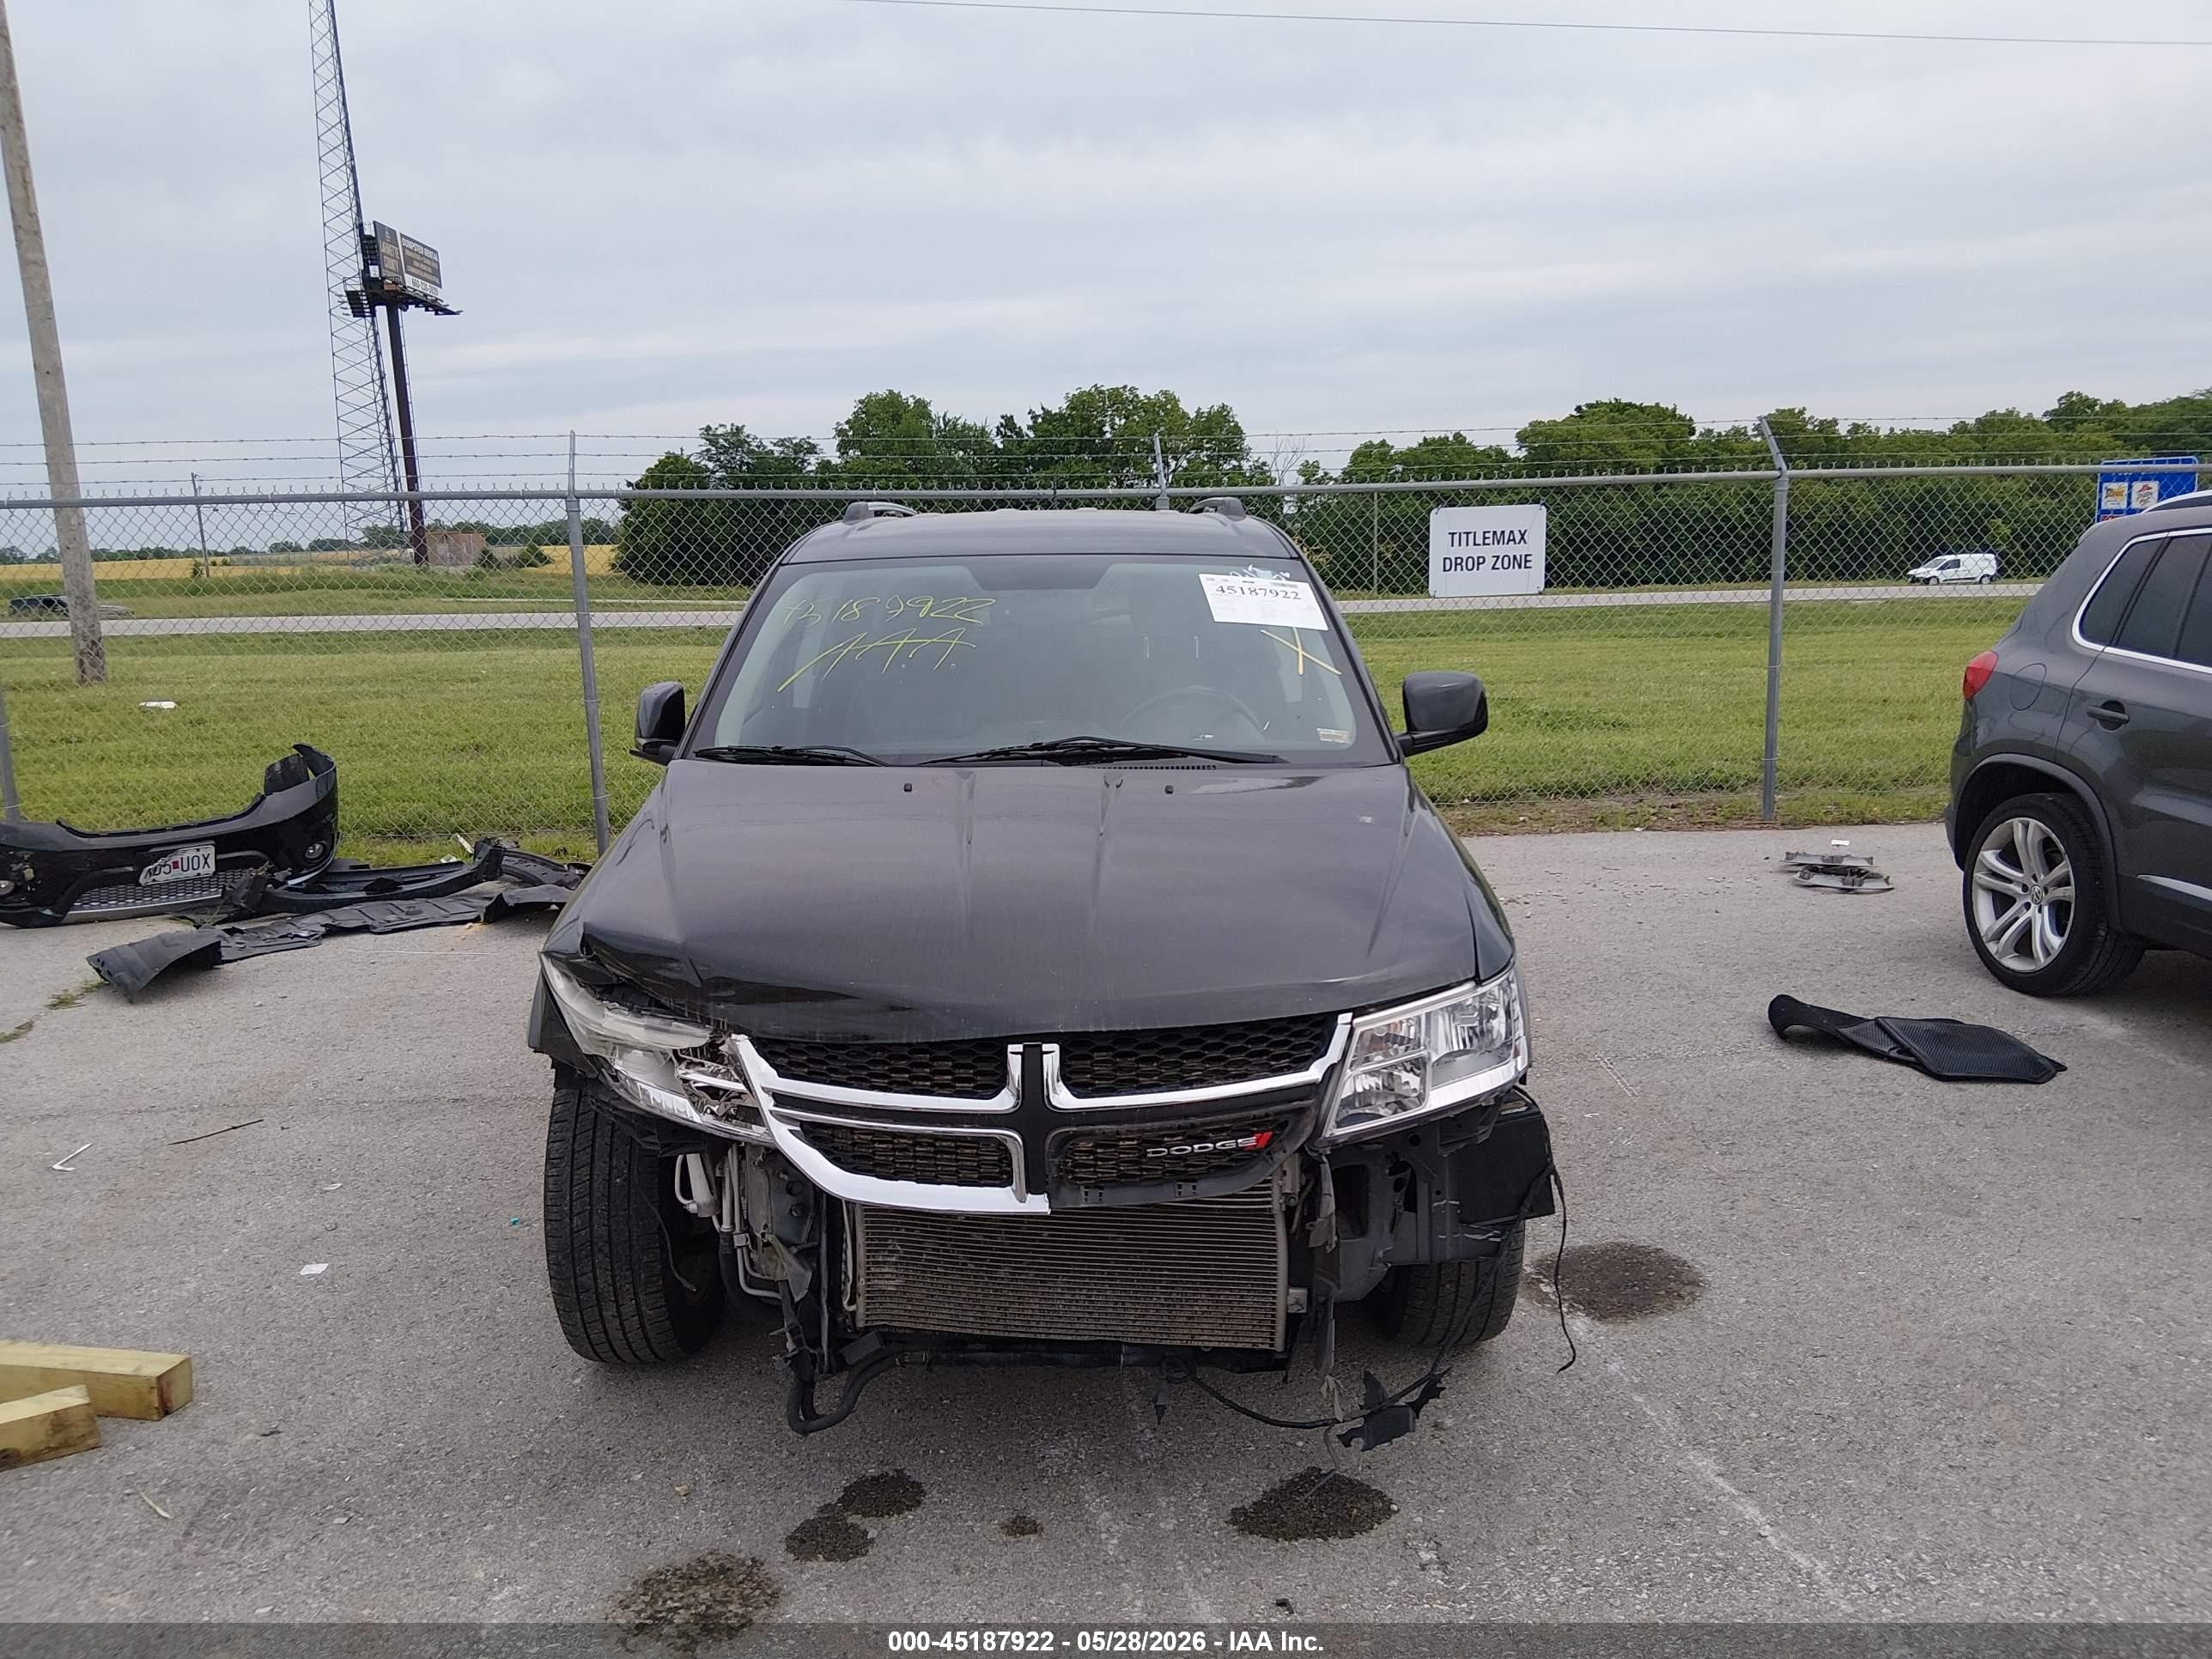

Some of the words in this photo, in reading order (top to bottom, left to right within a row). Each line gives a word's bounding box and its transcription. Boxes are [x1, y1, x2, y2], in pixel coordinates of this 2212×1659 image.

[1448, 529, 1528, 548] TITLEMAX
[1442, 556, 1486, 573] DROP
[1491, 554, 1533, 571] ZONE
[1215, 585, 1302, 600] 45187922
[1146, 1135, 1258, 1158] DODGE
